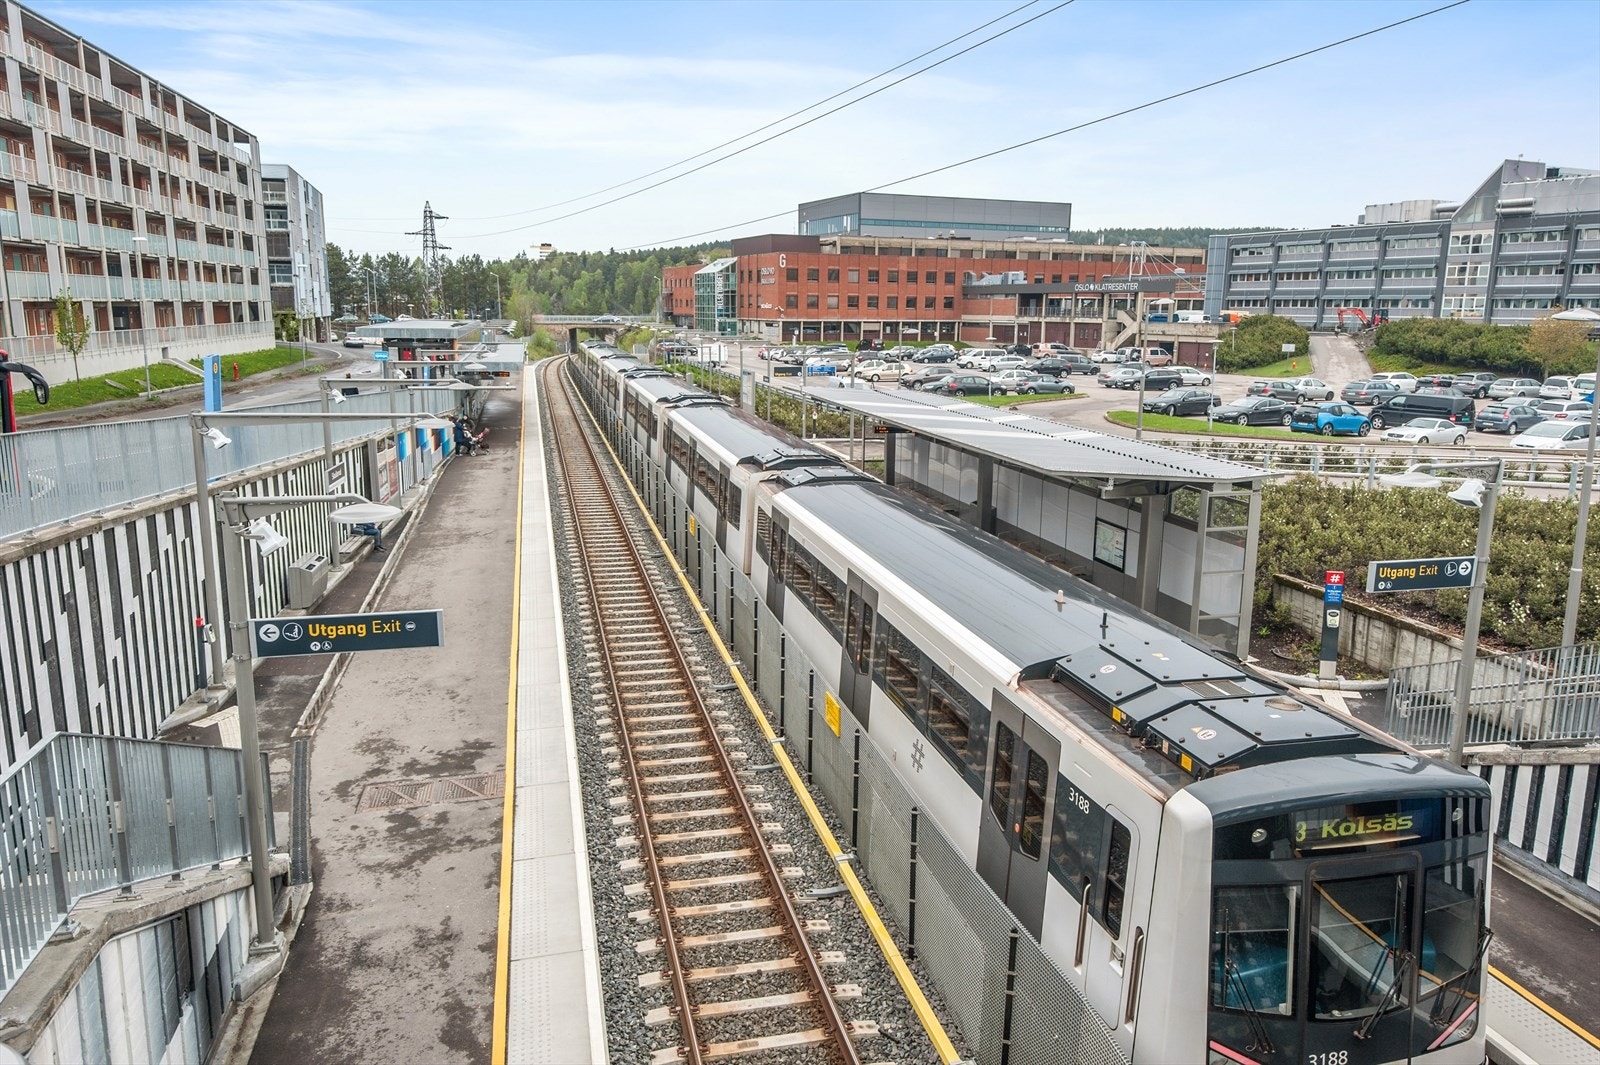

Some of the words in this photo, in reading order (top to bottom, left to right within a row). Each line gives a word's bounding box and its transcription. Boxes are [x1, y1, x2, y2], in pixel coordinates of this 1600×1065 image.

[779, 253, 787, 268] G
[1074, 283, 1090, 291] OSLO
[1094, 282, 1139, 291] KLATRESENTER
[1379, 566, 1416, 580] Utgang
[1419, 565, 1439, 576] Exit
[308, 622, 367, 638] Utgang
[372, 620, 401, 634] Exit
[1068, 787, 1090, 815] 3188
[1321, 812, 1414, 839] Kolsås
[1308, 1050, 1348, 1065] 3188
